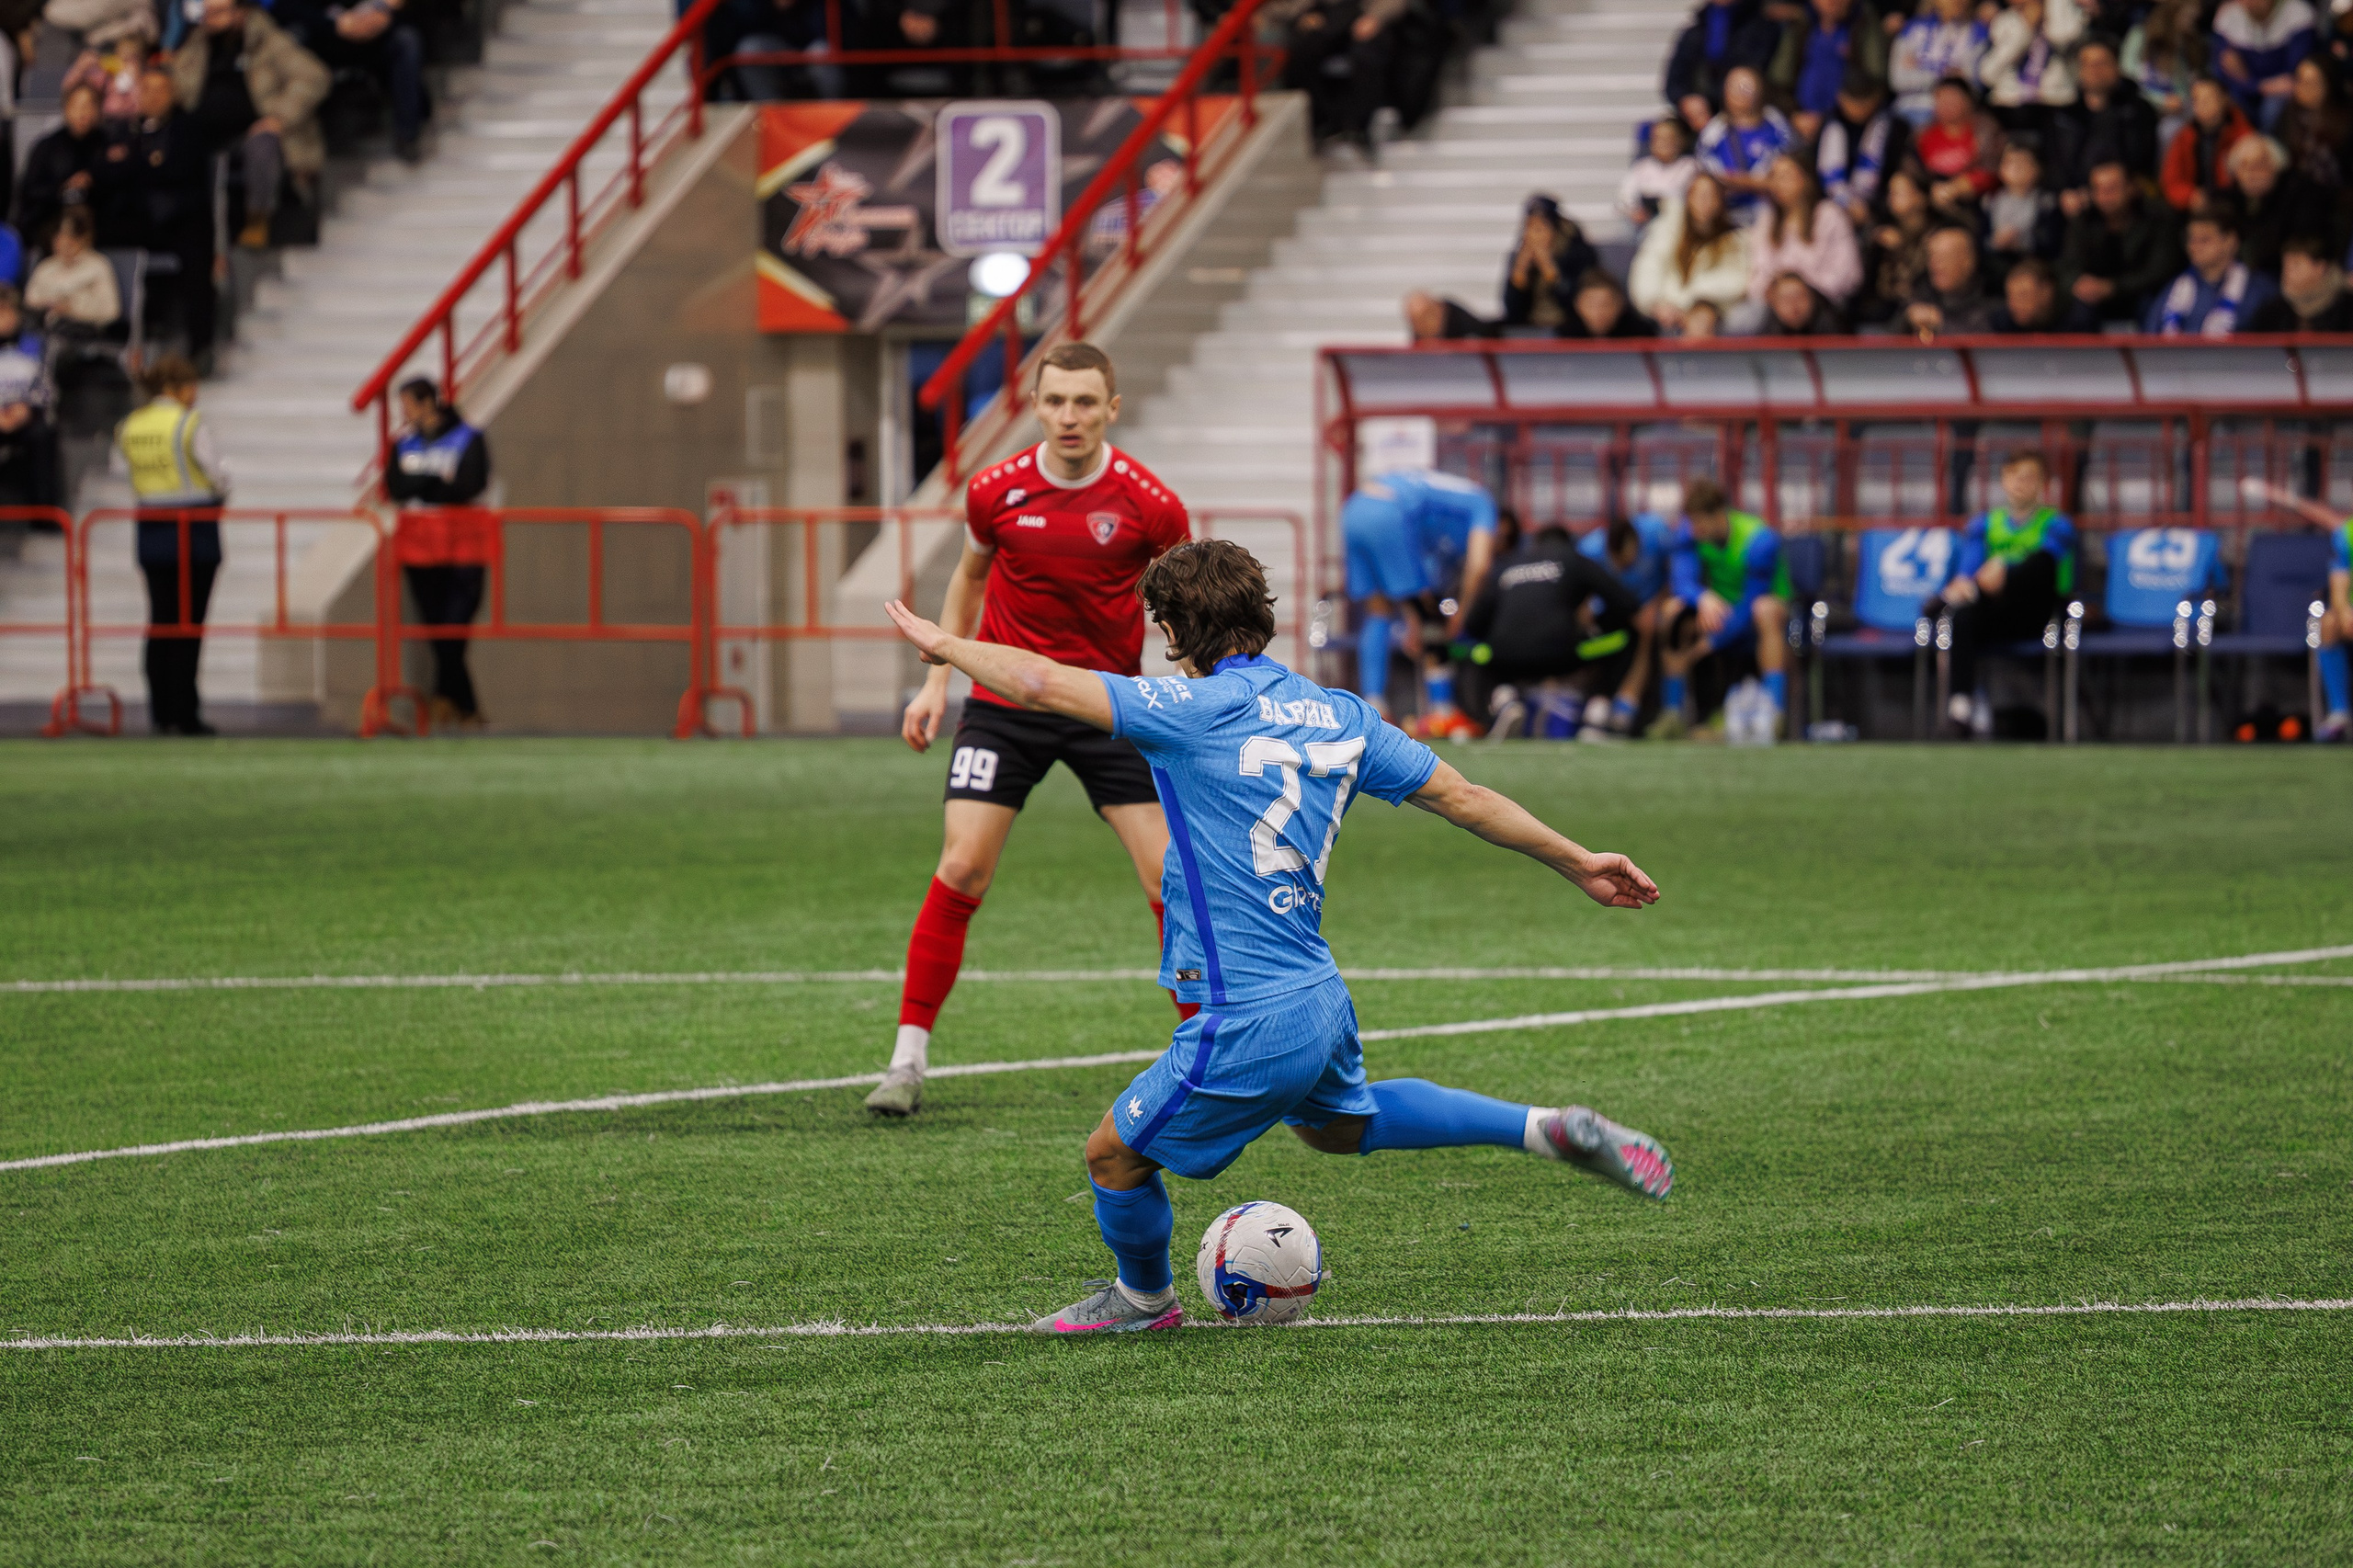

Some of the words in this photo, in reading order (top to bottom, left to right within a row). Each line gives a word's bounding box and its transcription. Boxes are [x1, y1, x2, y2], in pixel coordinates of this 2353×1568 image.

[970, 117, 1028, 208] 2
[949, 745, 999, 792] 99
[1239, 735, 1367, 886] 27
